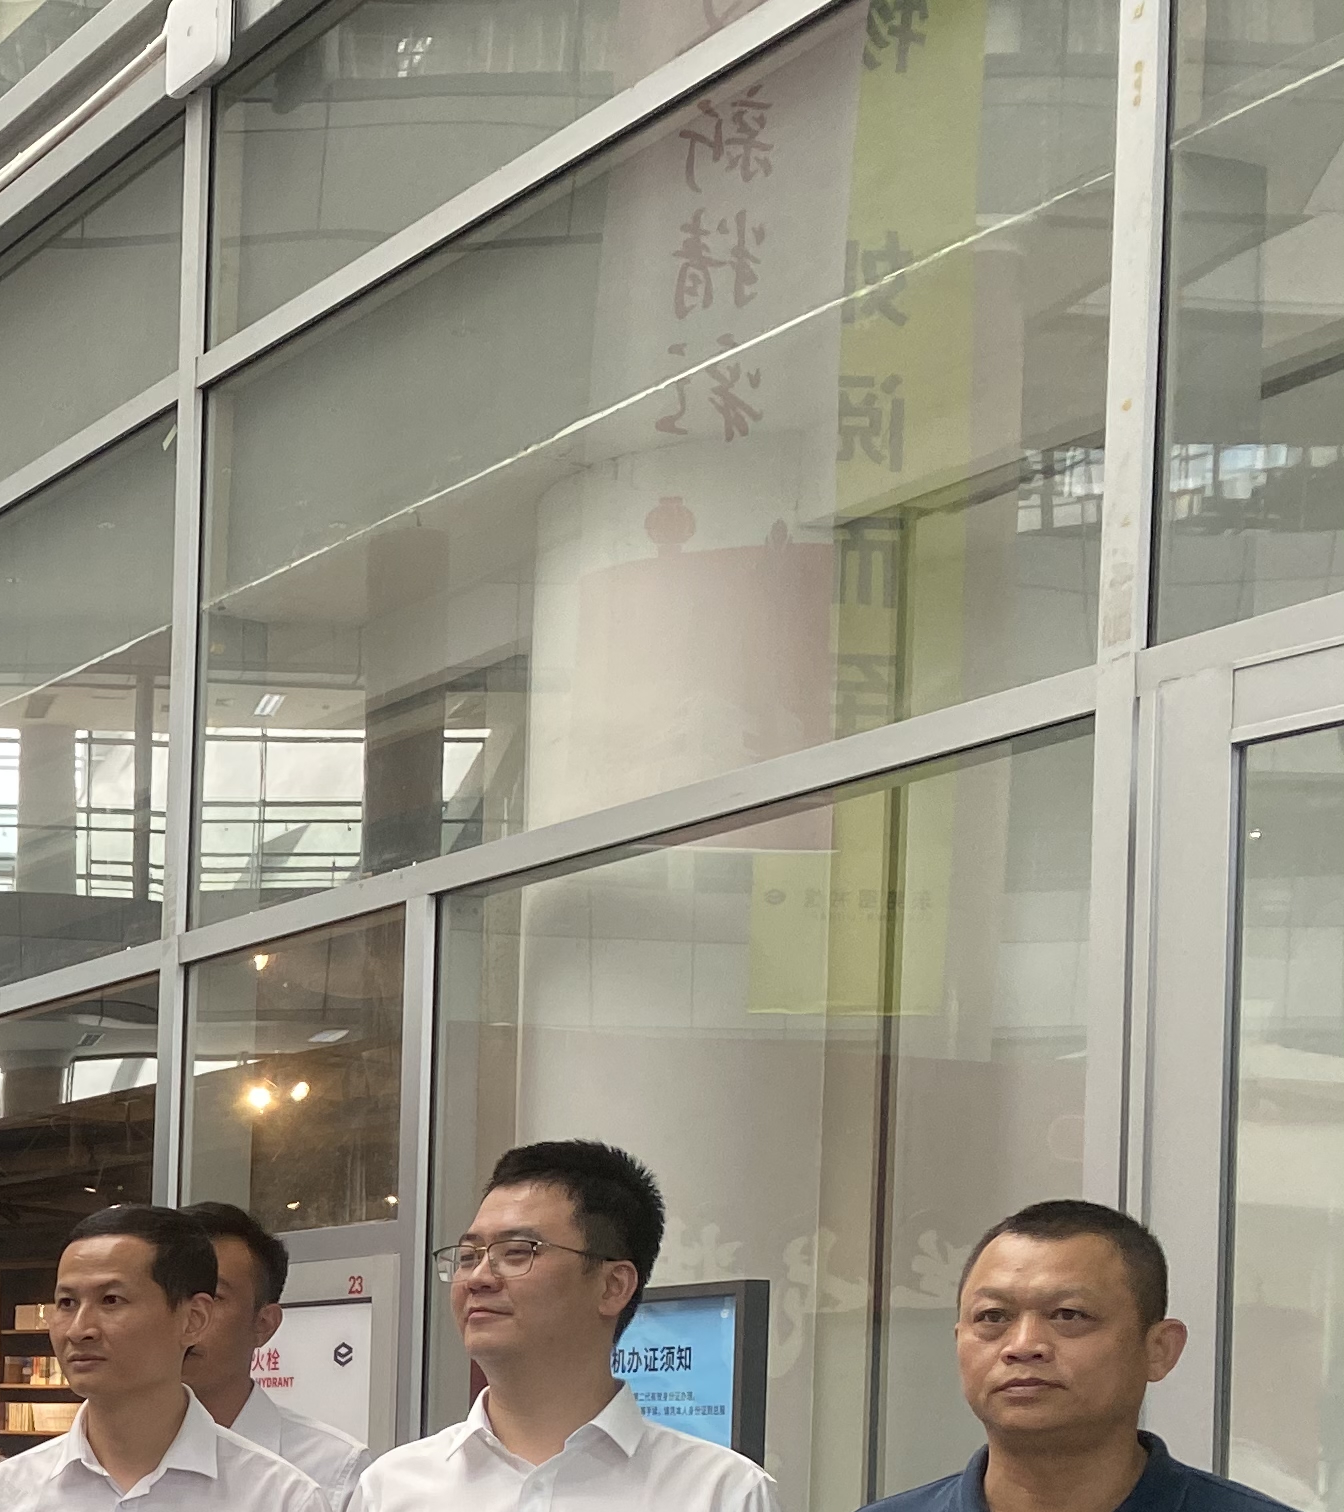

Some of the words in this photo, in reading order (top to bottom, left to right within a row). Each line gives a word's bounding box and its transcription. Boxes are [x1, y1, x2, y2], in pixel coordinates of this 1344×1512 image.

[348, 1275, 364, 1295] 23
[612, 1345, 692, 1374] 机办证须知
